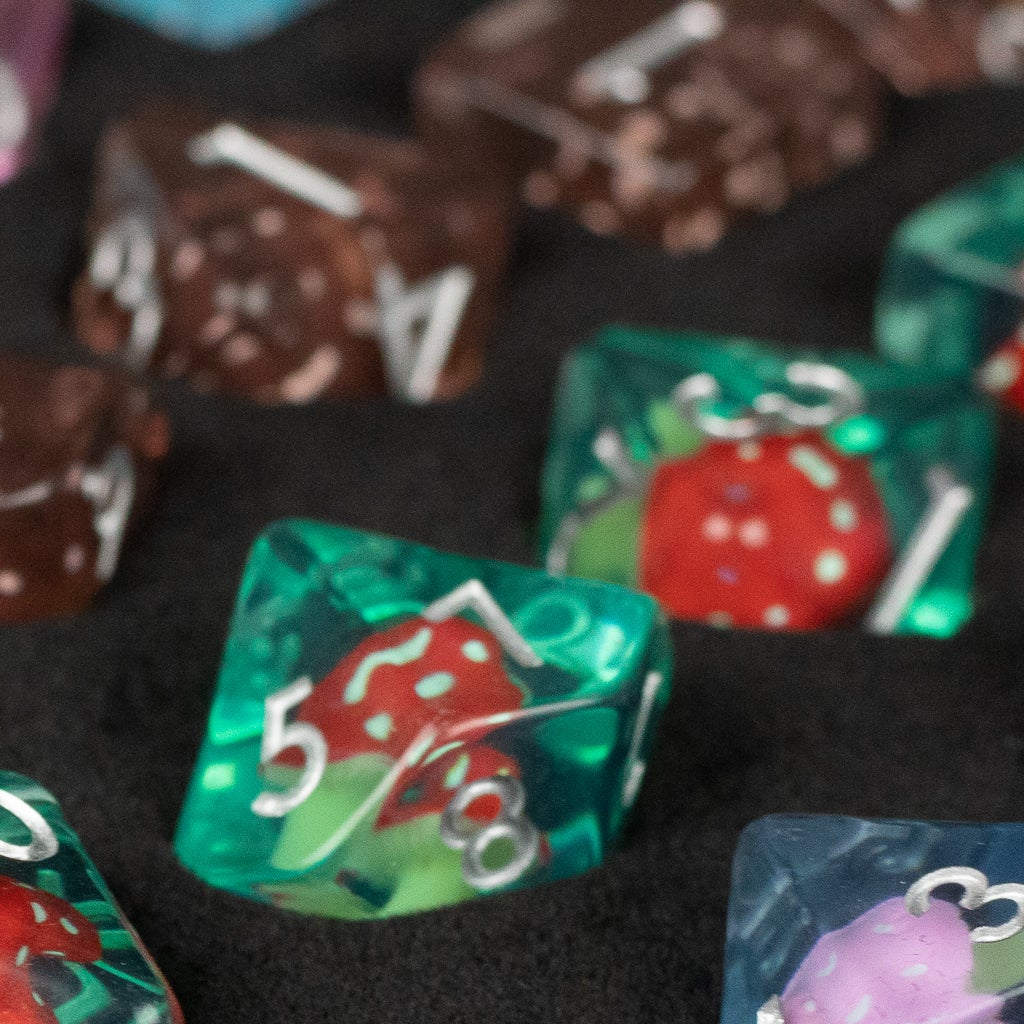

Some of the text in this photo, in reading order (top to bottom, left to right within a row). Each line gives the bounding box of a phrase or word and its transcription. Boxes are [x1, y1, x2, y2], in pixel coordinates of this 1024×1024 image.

[250, 675, 330, 818] 5
[440, 775, 539, 889] 8
[904, 865, 1024, 942] 3
